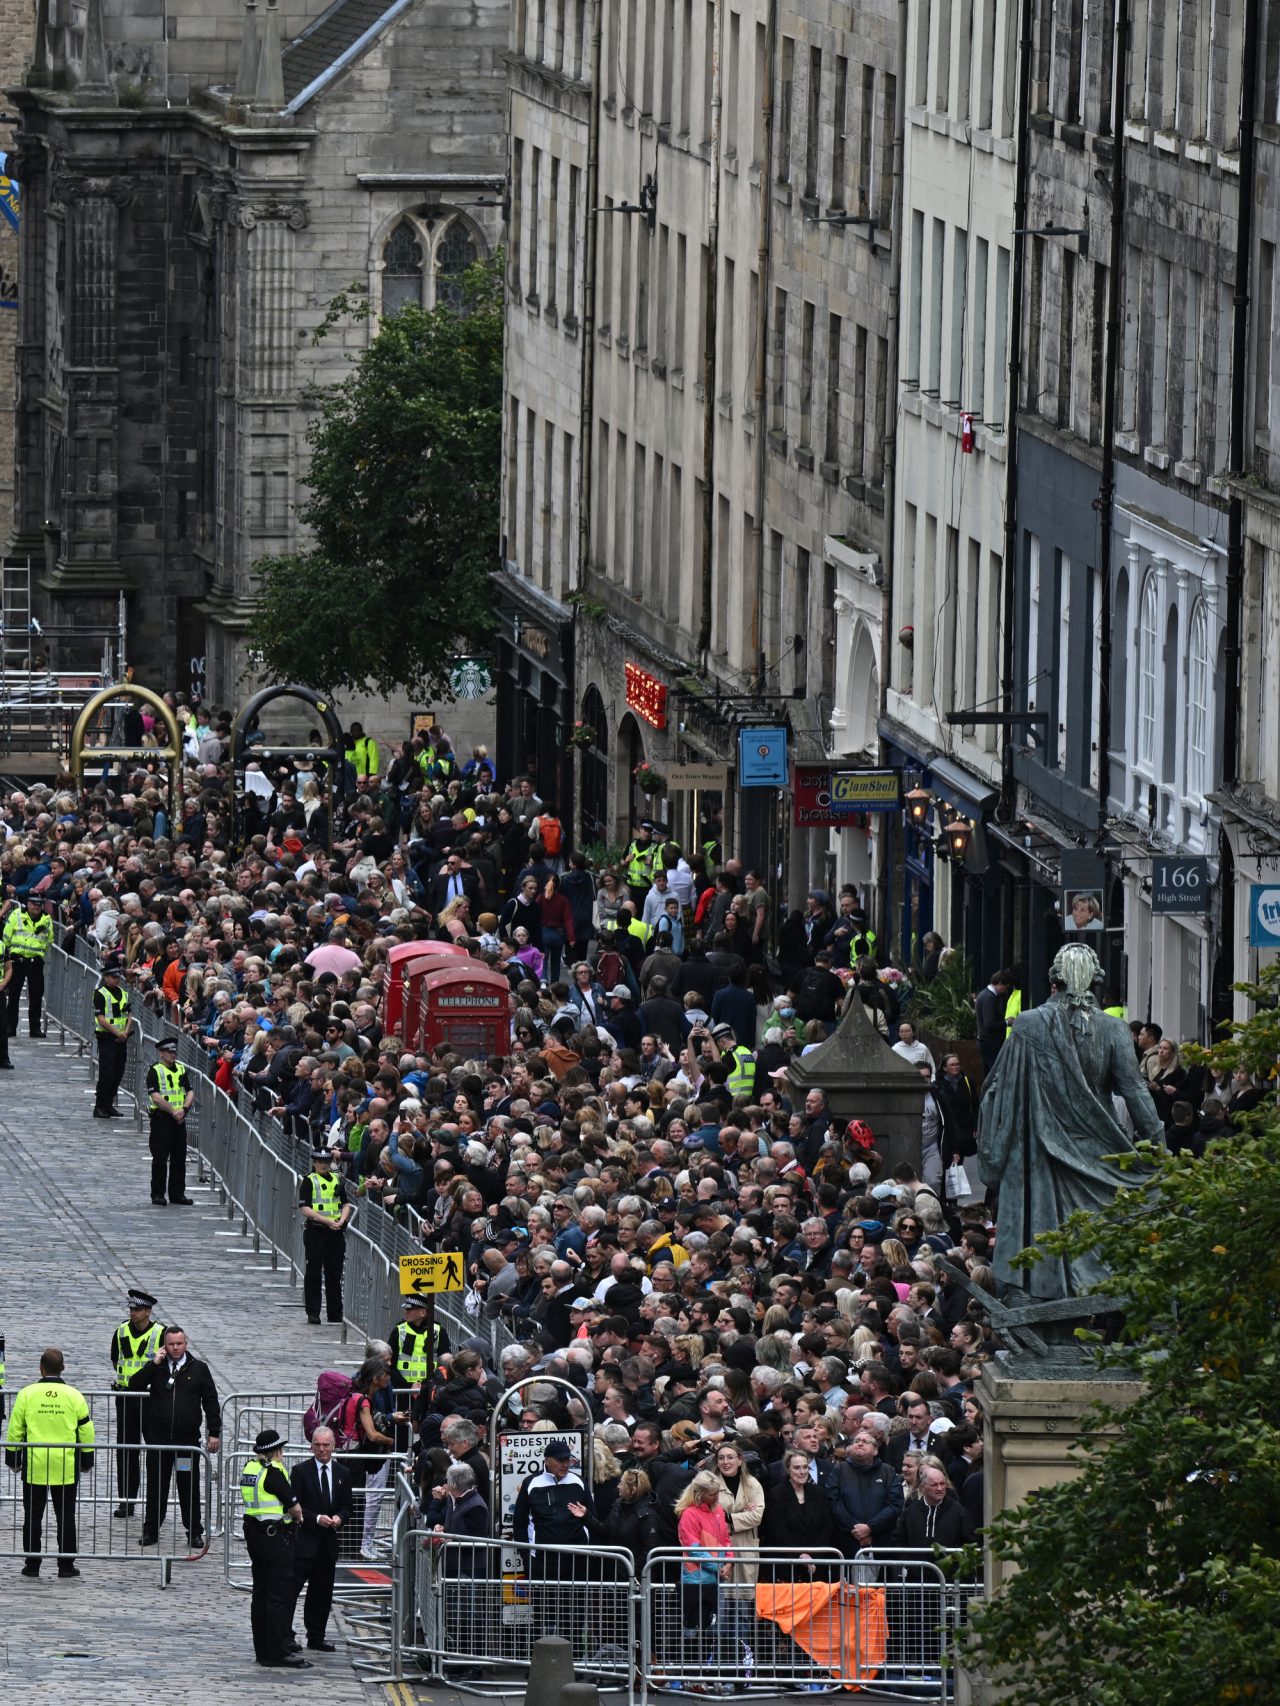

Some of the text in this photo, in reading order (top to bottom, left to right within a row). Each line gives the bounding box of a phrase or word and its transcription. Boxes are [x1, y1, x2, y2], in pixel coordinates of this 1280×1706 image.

[1160, 867, 1200, 887] 166
[1157, 893, 1201, 903] High Street
[441, 997, 497, 1006] TELEPHONE
[401, 1257, 443, 1267] CROSSING
[410, 1267, 434, 1276] POINT
[516, 1460, 545, 1475] ZO
